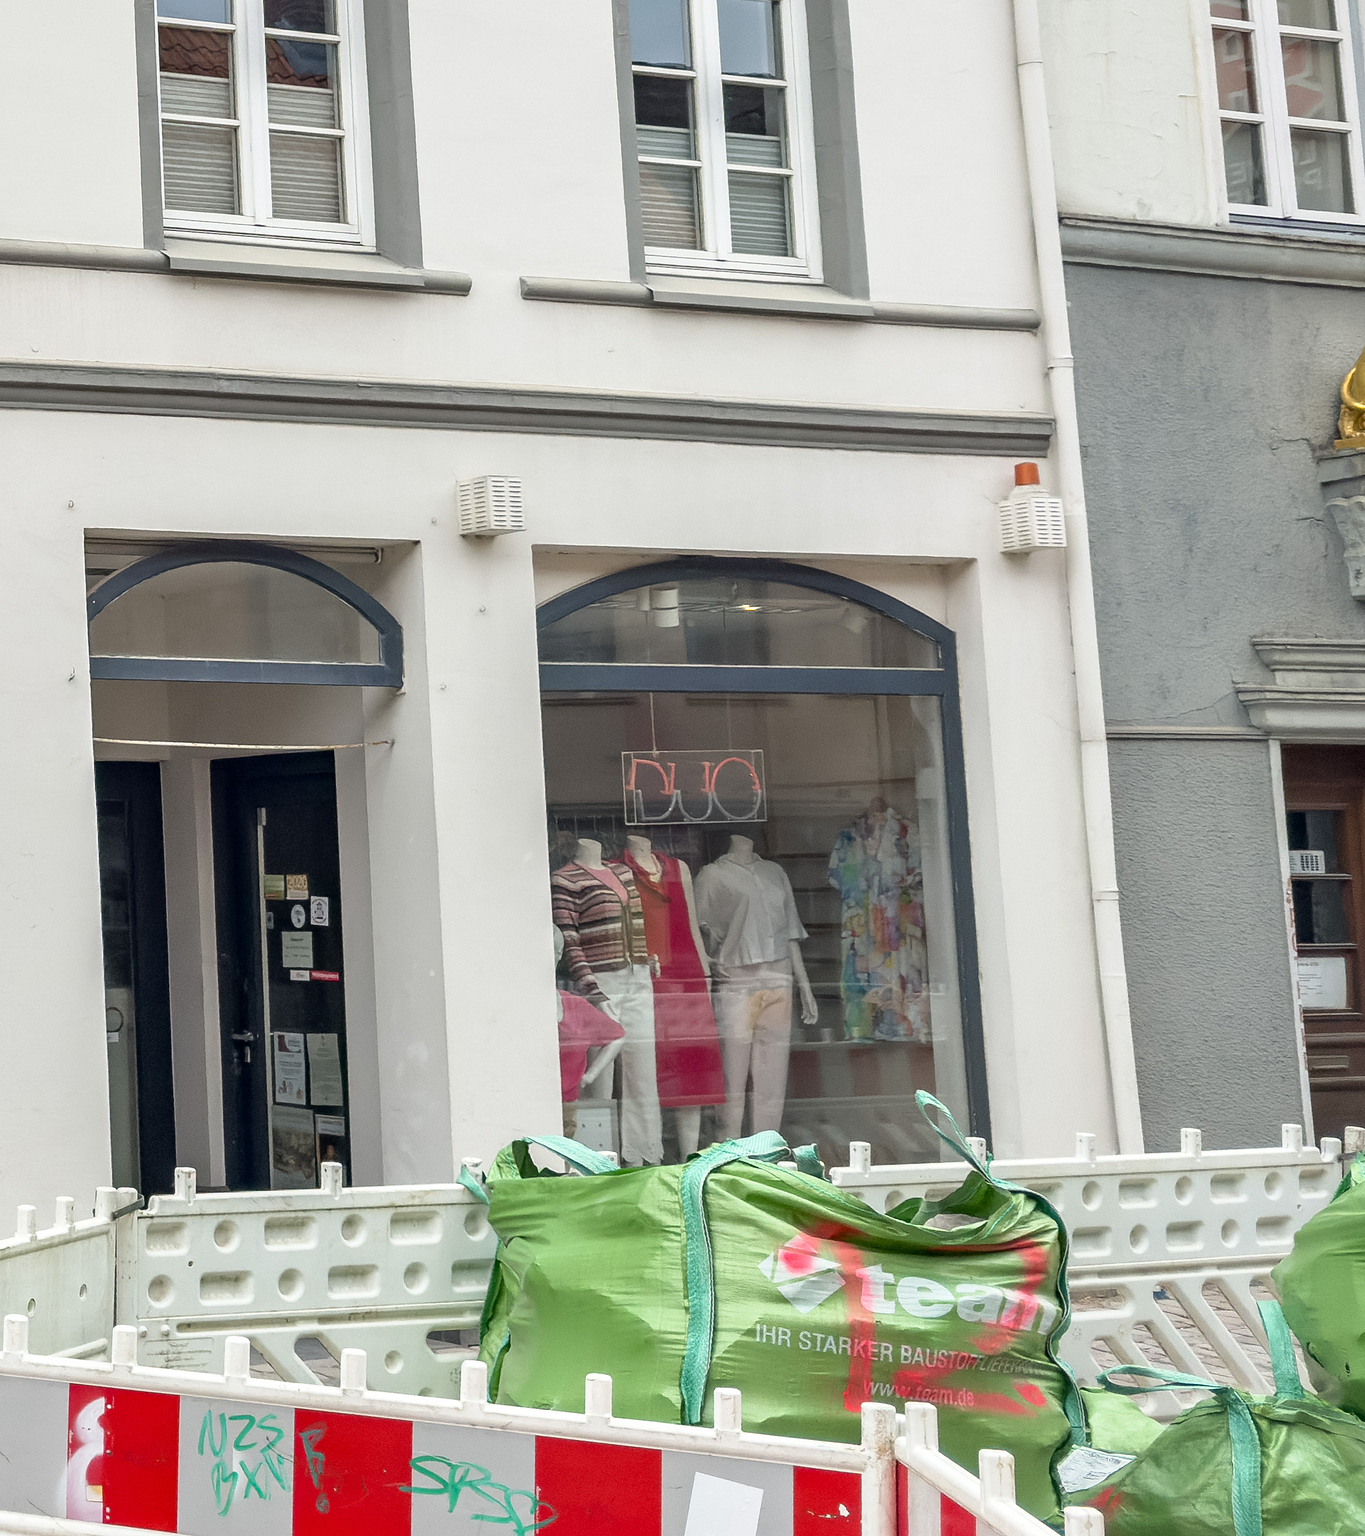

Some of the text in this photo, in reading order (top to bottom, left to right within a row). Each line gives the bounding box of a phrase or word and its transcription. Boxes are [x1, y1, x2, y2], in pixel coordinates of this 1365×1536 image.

[625, 756, 763, 822] DUO
[856, 1263, 1063, 1336] team
[755, 1323, 792, 1348] IHR
[798, 1331, 894, 1364] STARKER
[863, 1379, 975, 1408] www.team.de
